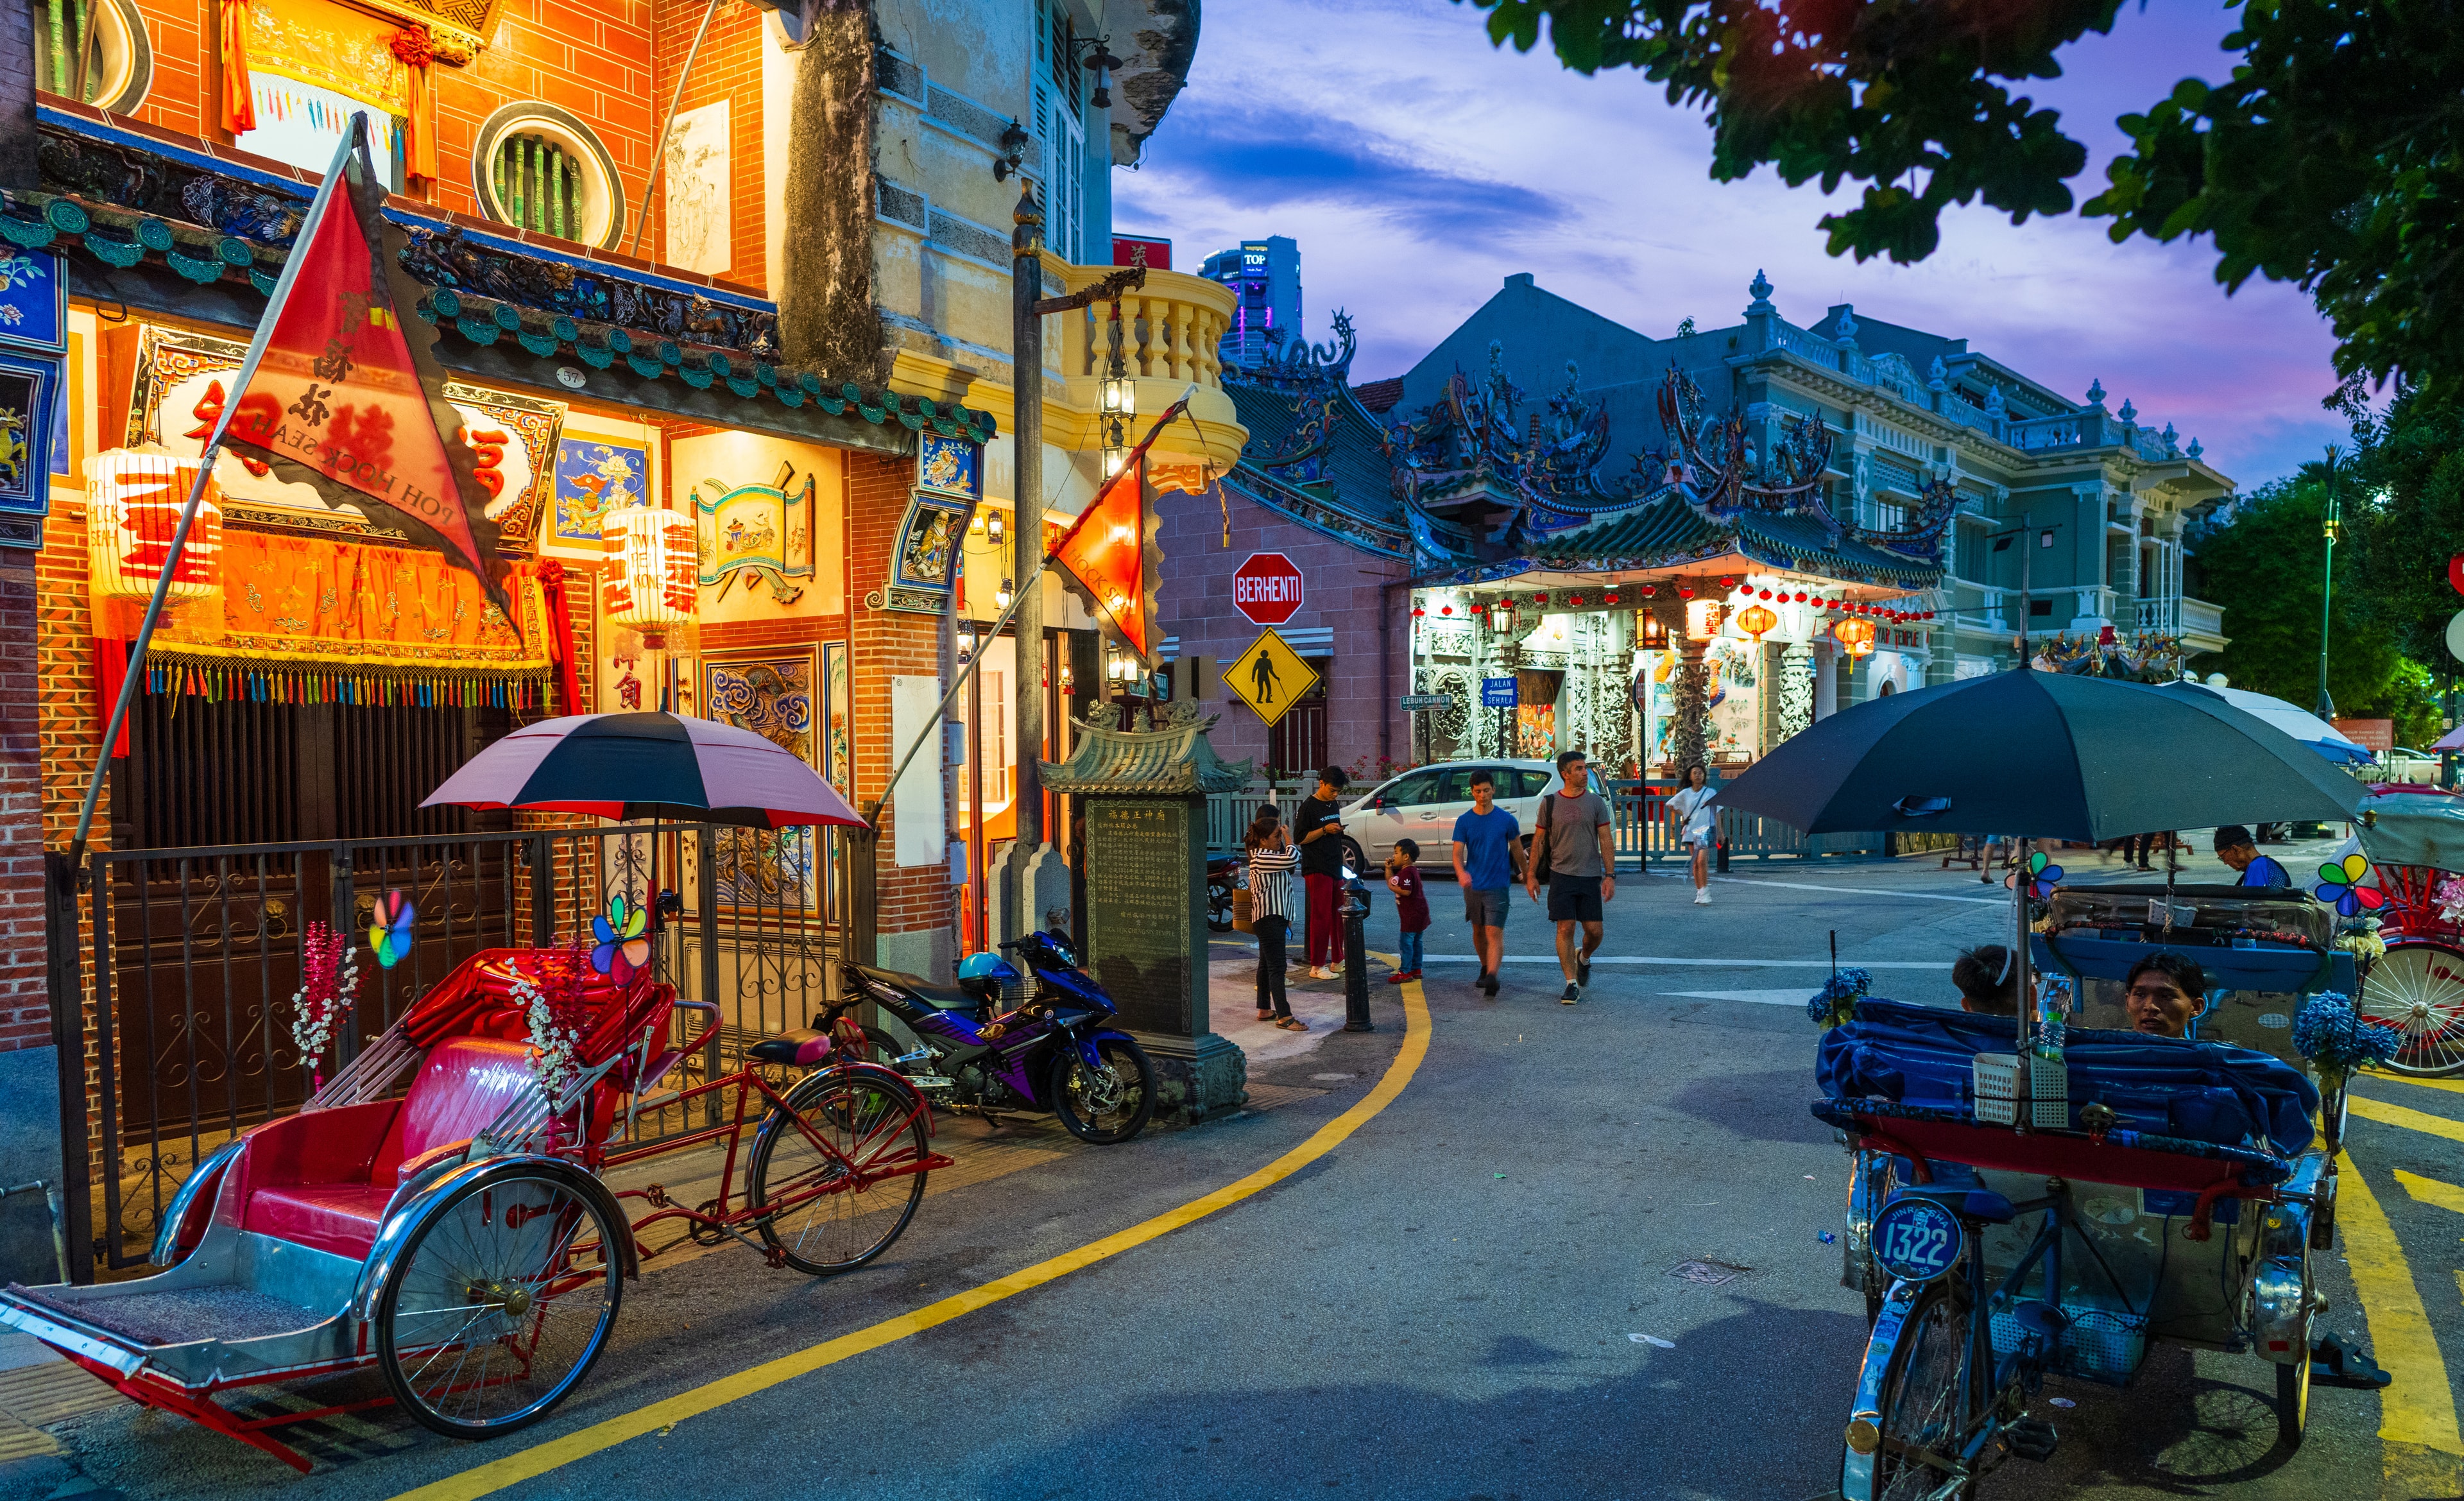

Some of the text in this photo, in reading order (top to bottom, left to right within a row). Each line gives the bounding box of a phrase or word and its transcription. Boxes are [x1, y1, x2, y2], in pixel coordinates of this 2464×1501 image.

[1244, 254, 1266, 264] TOP
[563, 371, 579, 383] 57
[89, 504, 121, 524] HOCK
[91, 529, 117, 547] SEAH
[1067, 548, 1108, 590] HOCK
[634, 574, 664, 590] KONG
[1237, 576, 1299, 603] BERHENTI
[1424, 696, 1450, 704] CANNON
[1883, 1222, 1948, 1267] 1322
